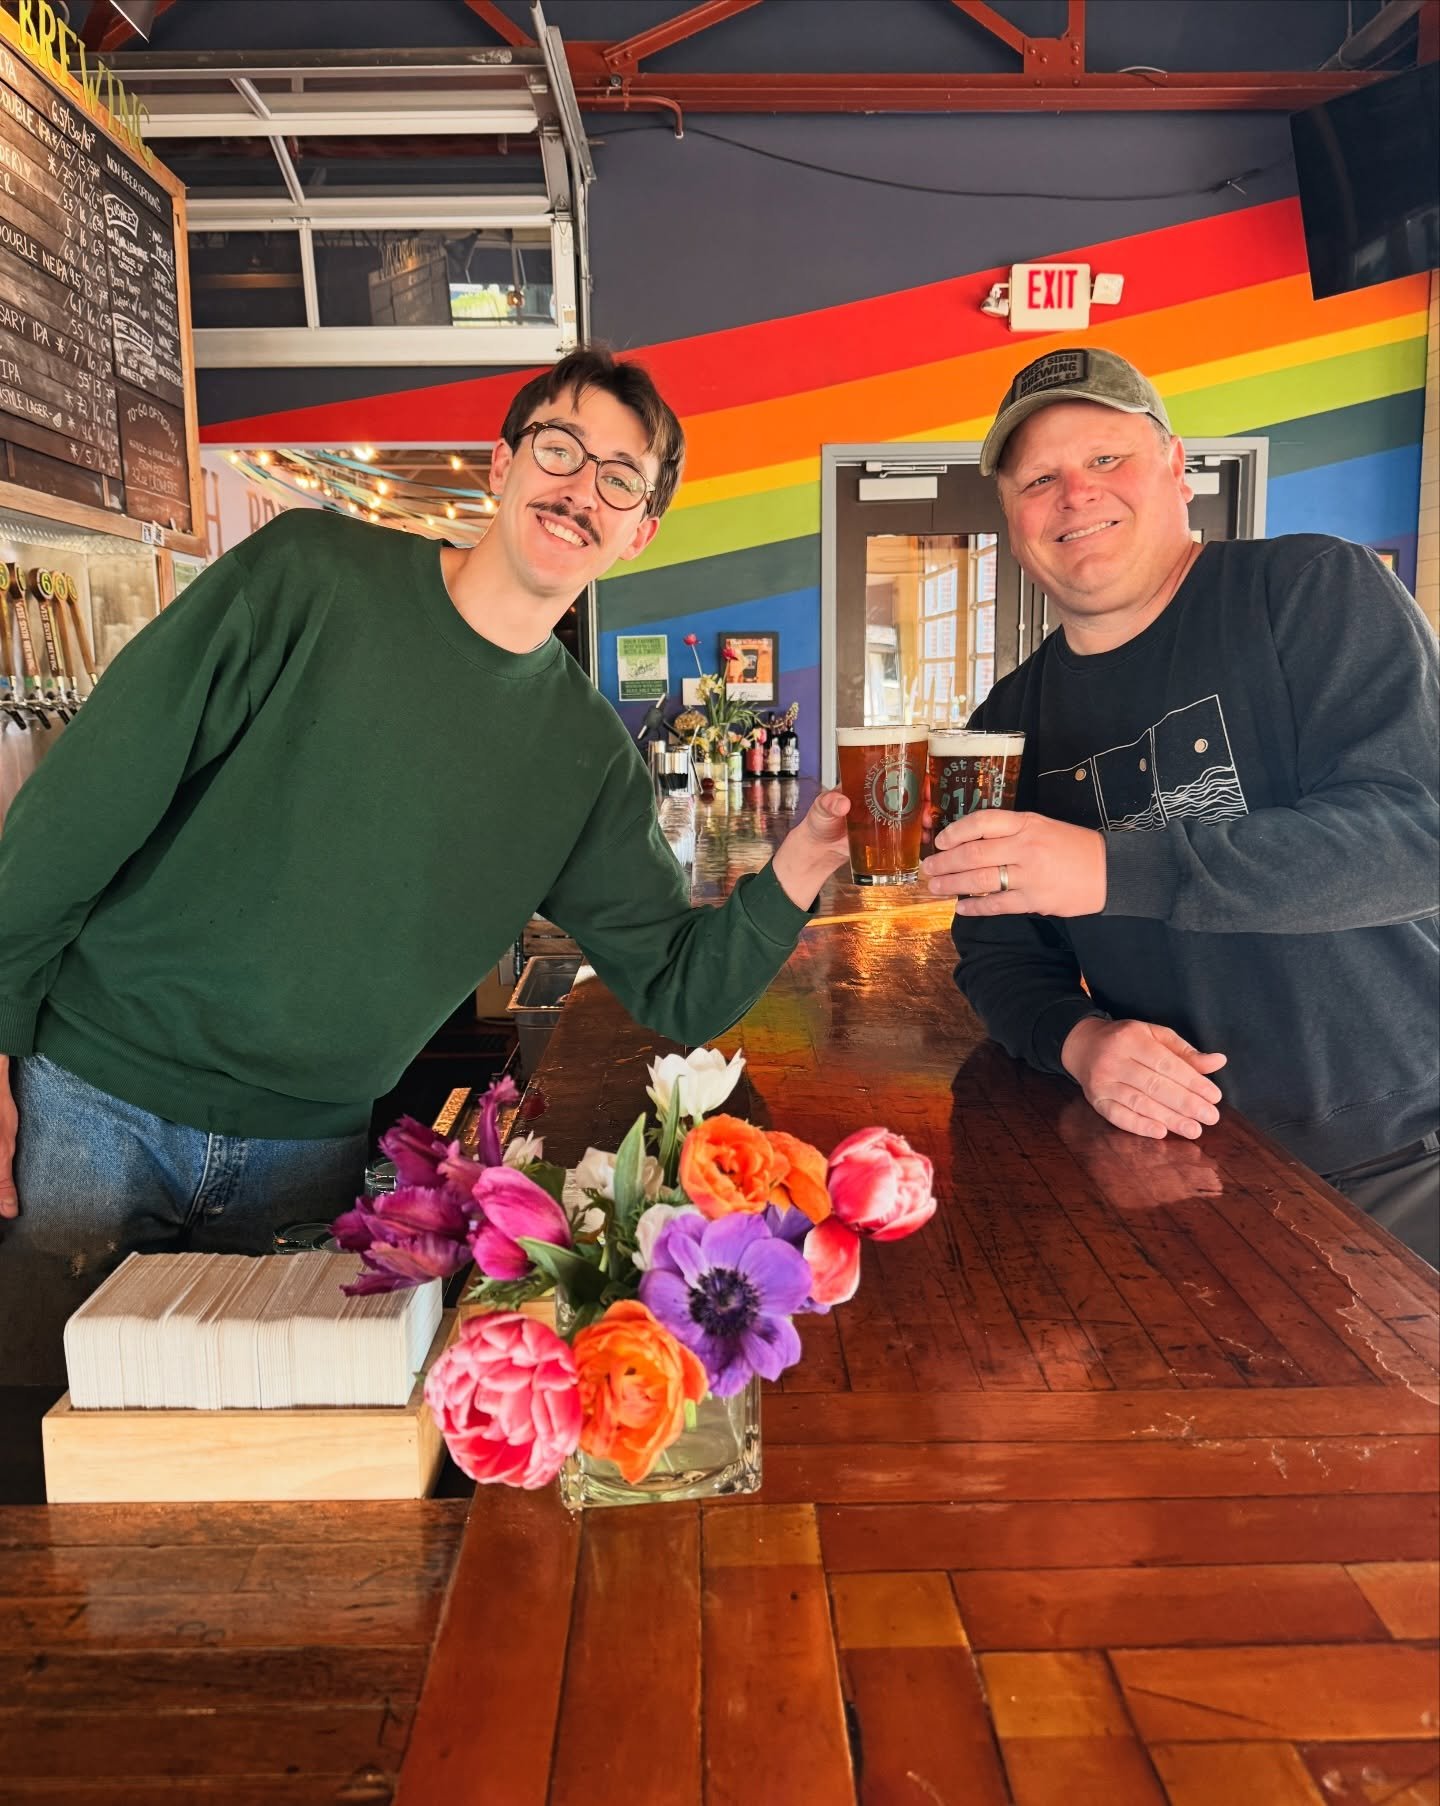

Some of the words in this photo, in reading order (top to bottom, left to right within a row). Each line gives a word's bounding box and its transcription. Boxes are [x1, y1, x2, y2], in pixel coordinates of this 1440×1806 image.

[19, 0, 155, 170] BREWING
[0, 225, 36, 260] OUBLE
[1027, 270, 1078, 309] EXIT
[32, 321, 49, 346] IPA
[1, 359, 21, 383] IPA
[1021, 361, 1077, 393] BREWING
